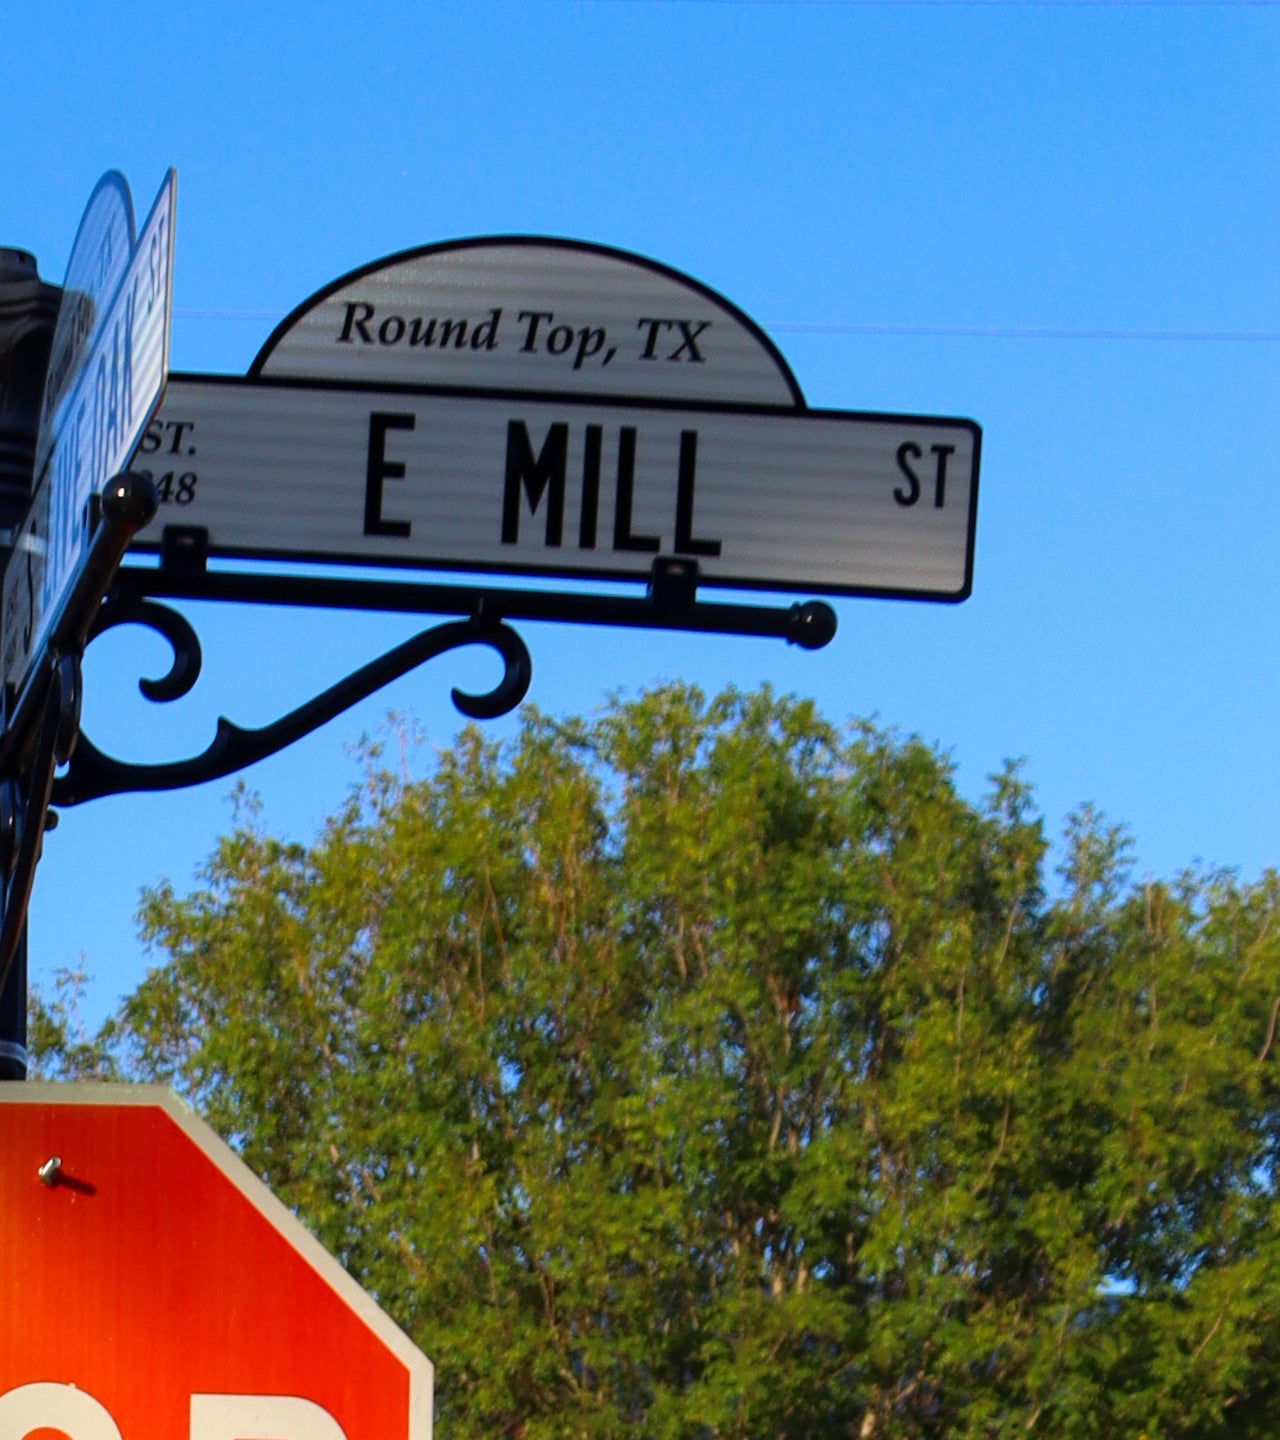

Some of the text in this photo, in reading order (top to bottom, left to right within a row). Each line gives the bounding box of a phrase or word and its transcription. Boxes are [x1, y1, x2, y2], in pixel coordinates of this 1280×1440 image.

[336, 301, 713, 371] Round Top, TX
[90, 274, 138, 494] OAK
[140, 419, 197, 456] ST.
[143, 470, 197, 507] 48
[363, 410, 955, 557] E MILL ST
